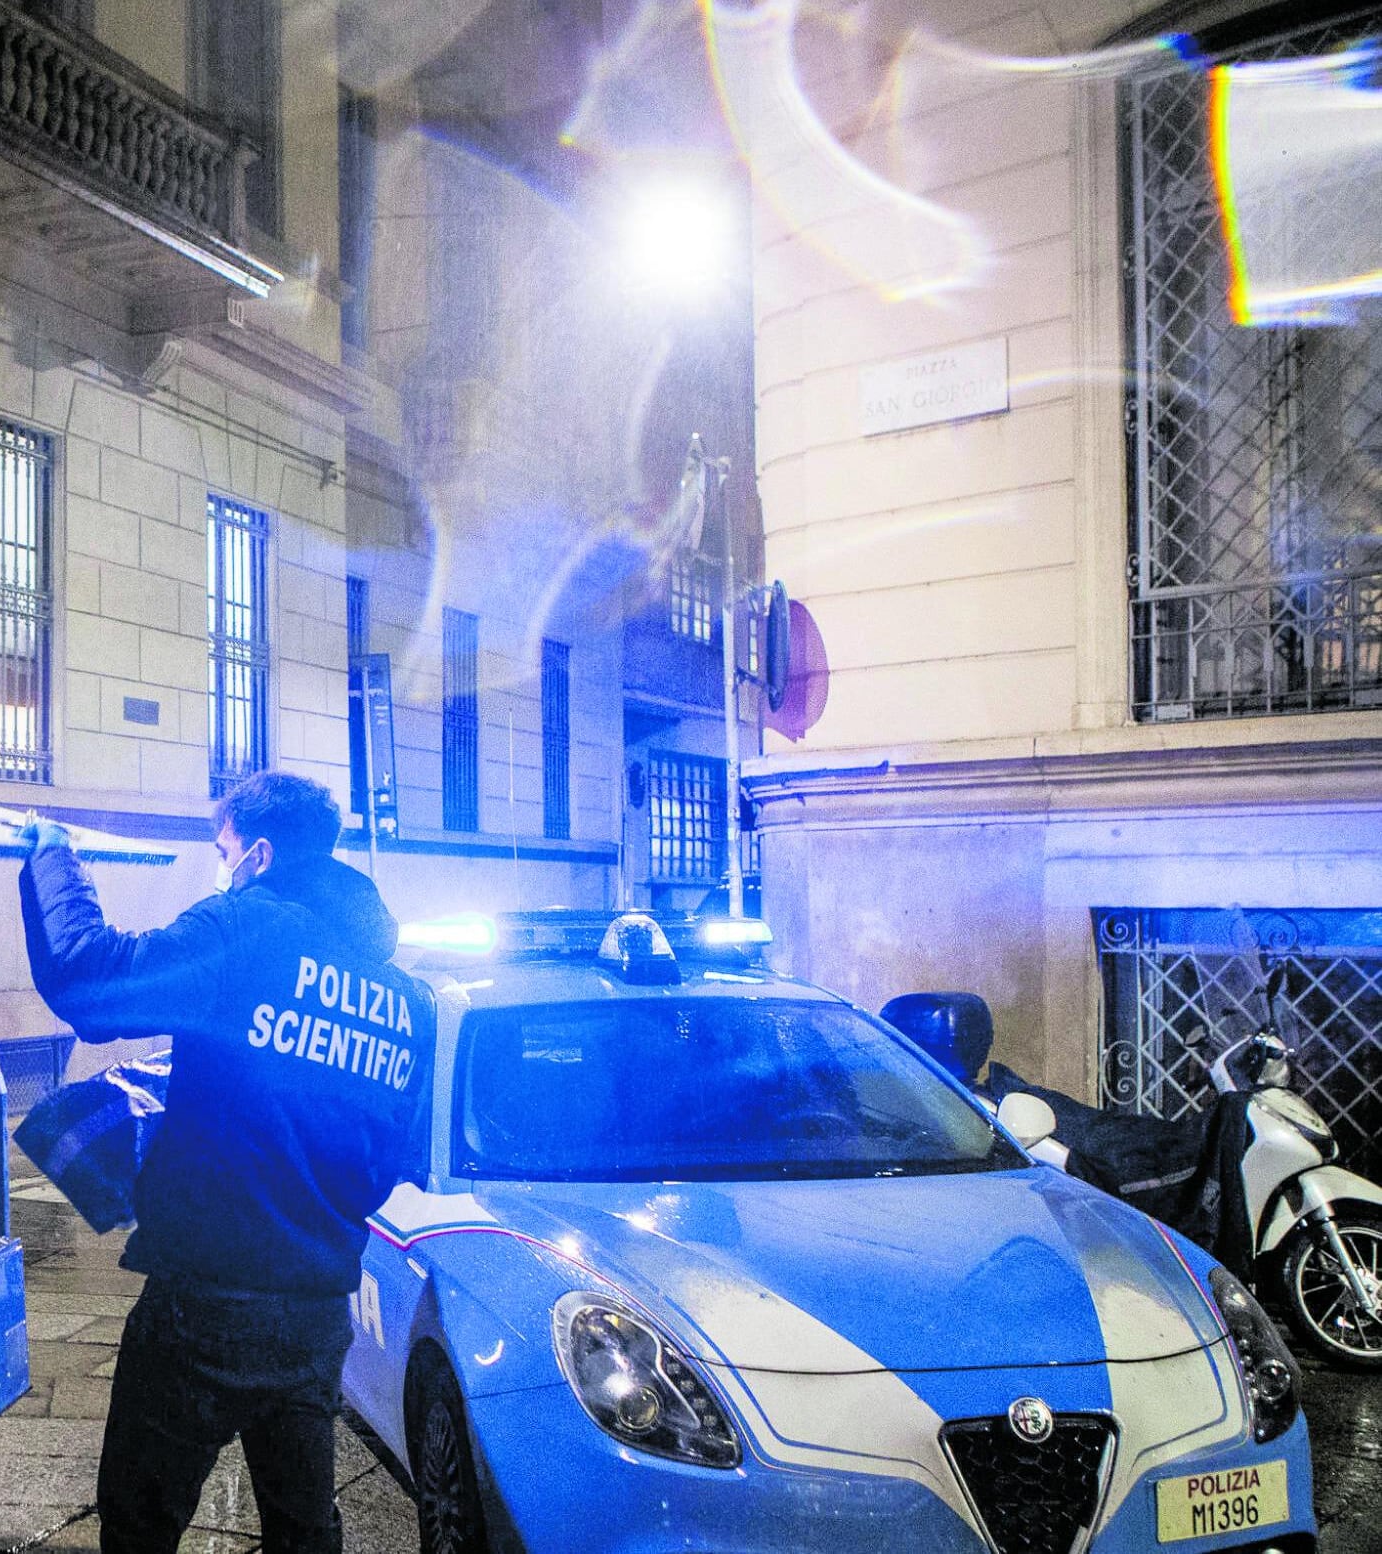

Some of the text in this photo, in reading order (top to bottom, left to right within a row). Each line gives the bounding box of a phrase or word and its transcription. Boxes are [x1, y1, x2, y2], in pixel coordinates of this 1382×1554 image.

[906, 358, 958, 380] PIAZZA
[866, 396, 900, 417] SAN
[294, 956, 412, 1037] POLIZIA
[1188, 1468, 1261, 1498] POLIZIA
[1192, 1494, 1259, 1535] M1396
